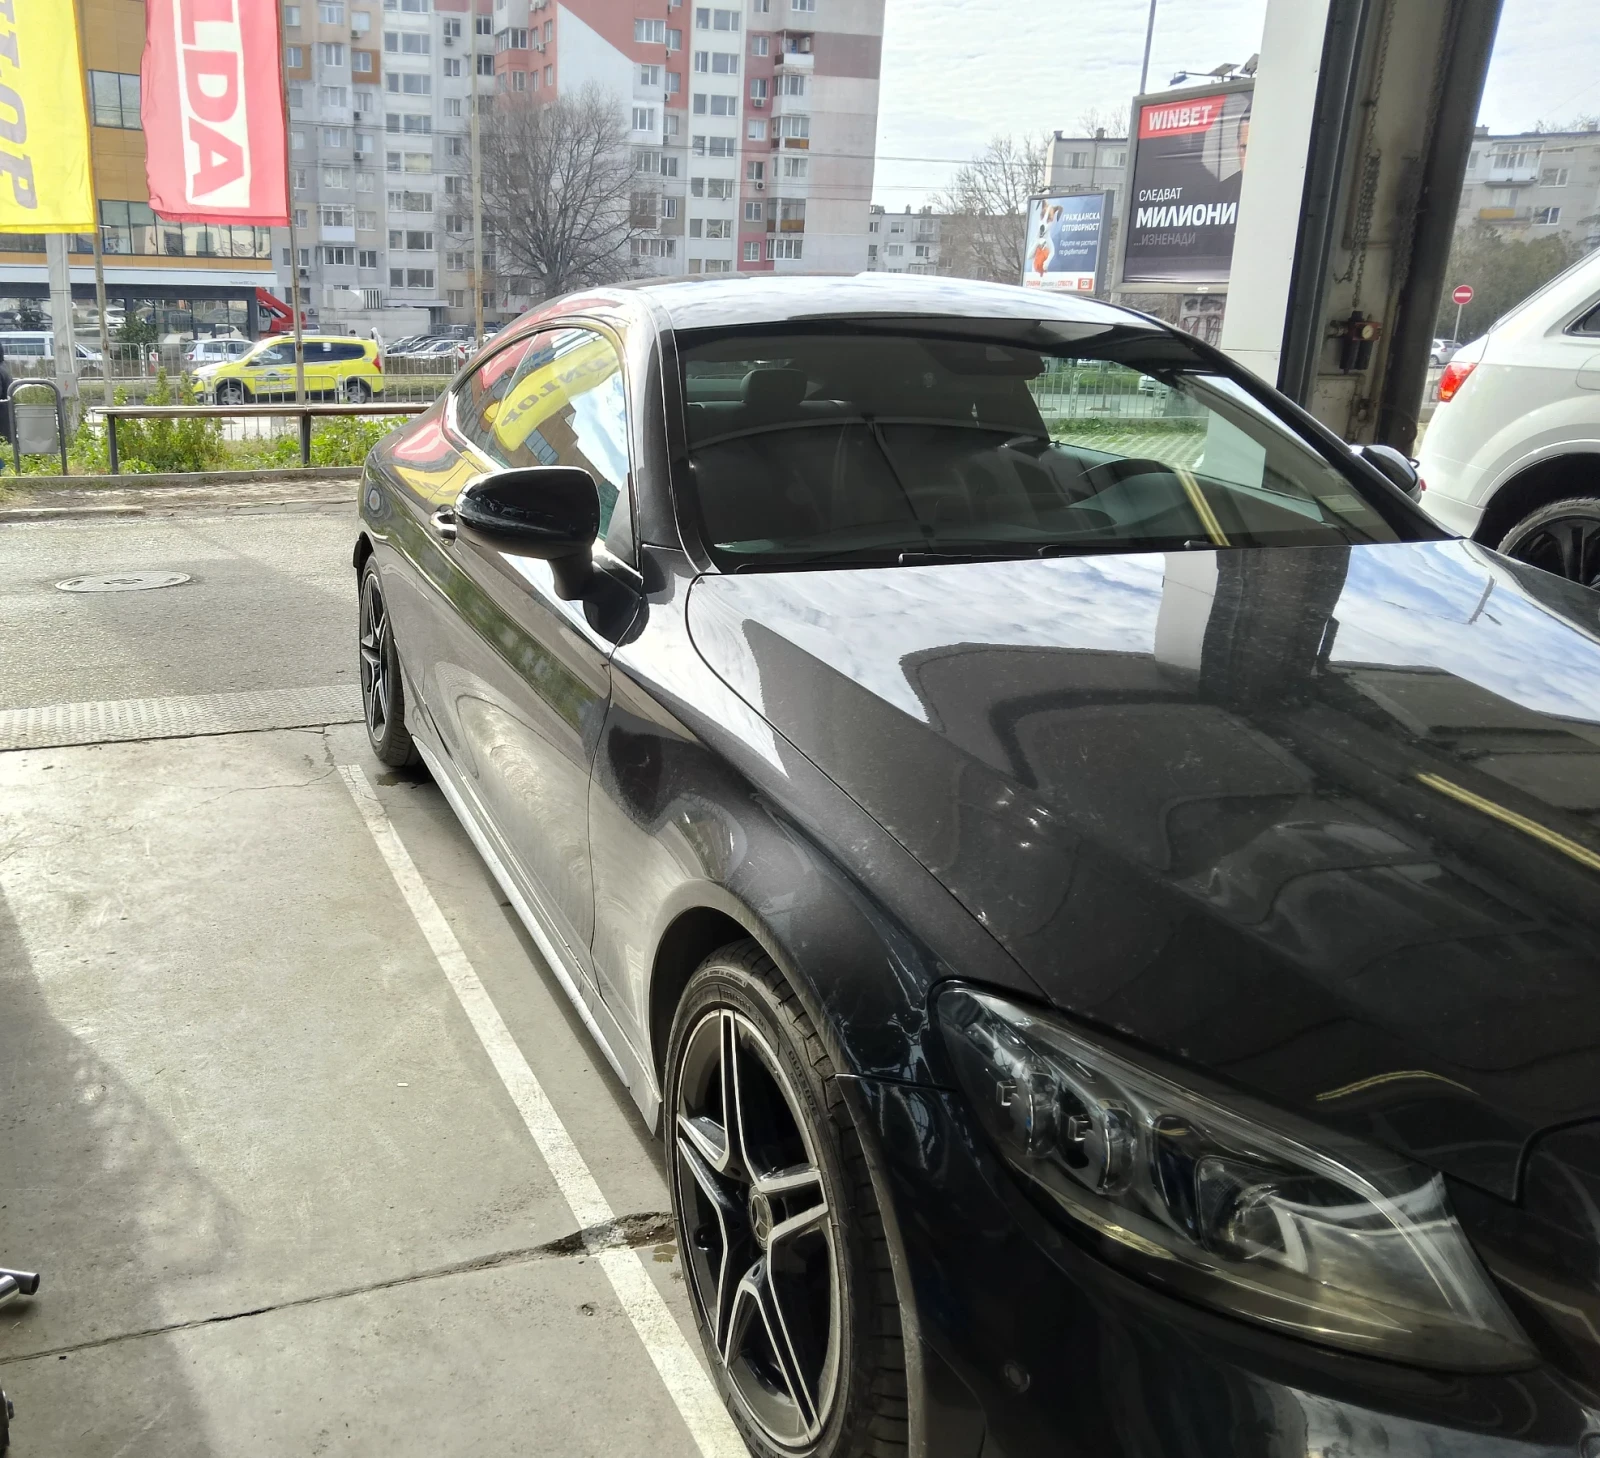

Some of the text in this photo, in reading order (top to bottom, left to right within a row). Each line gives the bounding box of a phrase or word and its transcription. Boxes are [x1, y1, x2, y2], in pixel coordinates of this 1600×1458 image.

[1149, 104, 1212, 131] WINBET
[1139, 187, 1183, 203] СЛЕДВАТ
[1062, 212, 1100, 222] ГРАЖДАНСКА
[1136, 202, 1237, 229] МИЛИОНИ
[1061, 223, 1099, 232] ОТГОВОРНОСТ
[788, 1050, 818, 1116] OUTSIDE
